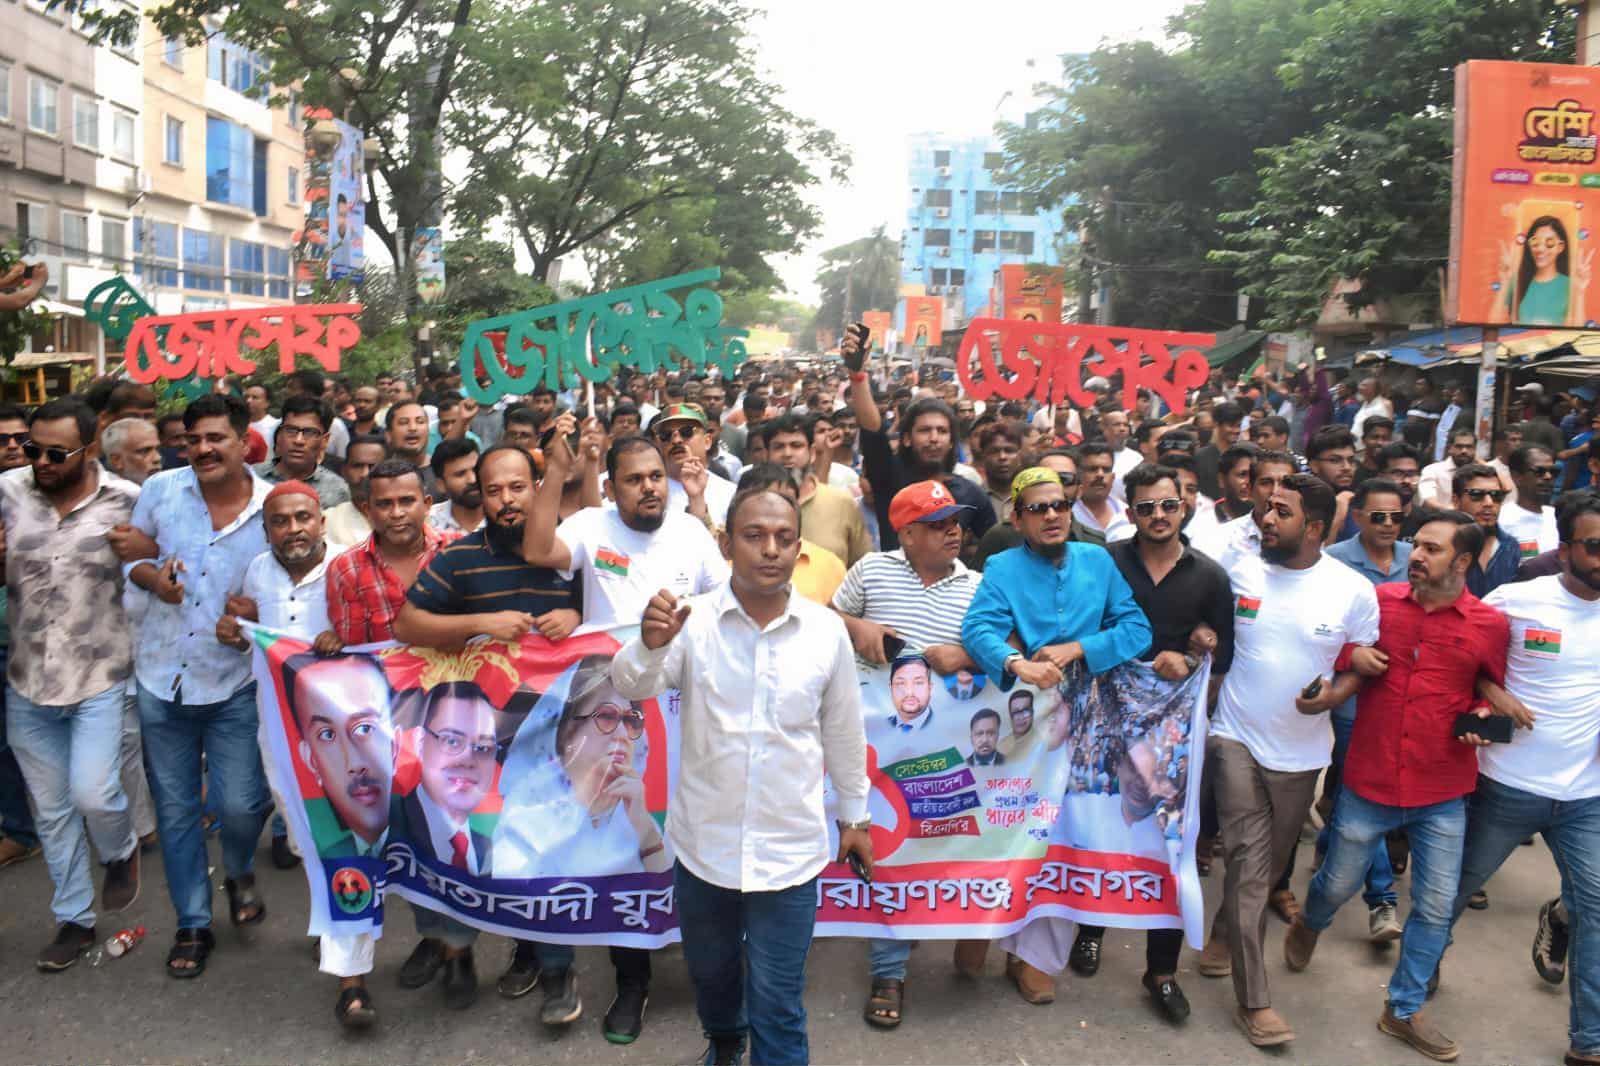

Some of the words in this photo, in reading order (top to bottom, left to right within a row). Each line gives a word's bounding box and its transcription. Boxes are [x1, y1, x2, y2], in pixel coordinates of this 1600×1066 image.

[1525, 101, 1593, 139] বেশি
[124, 303, 364, 384] জোসেফ
[461, 265, 722, 404] জোসেফ
[957, 317, 1217, 415] জোসেফ
[896, 756, 948, 778] সেপ্টেম্বর
[904, 774, 963, 796] বাংলাদেশ
[611, 885, 675, 928] যুব
[816, 876, 1012, 915] ারায়ণগঞ্জ
